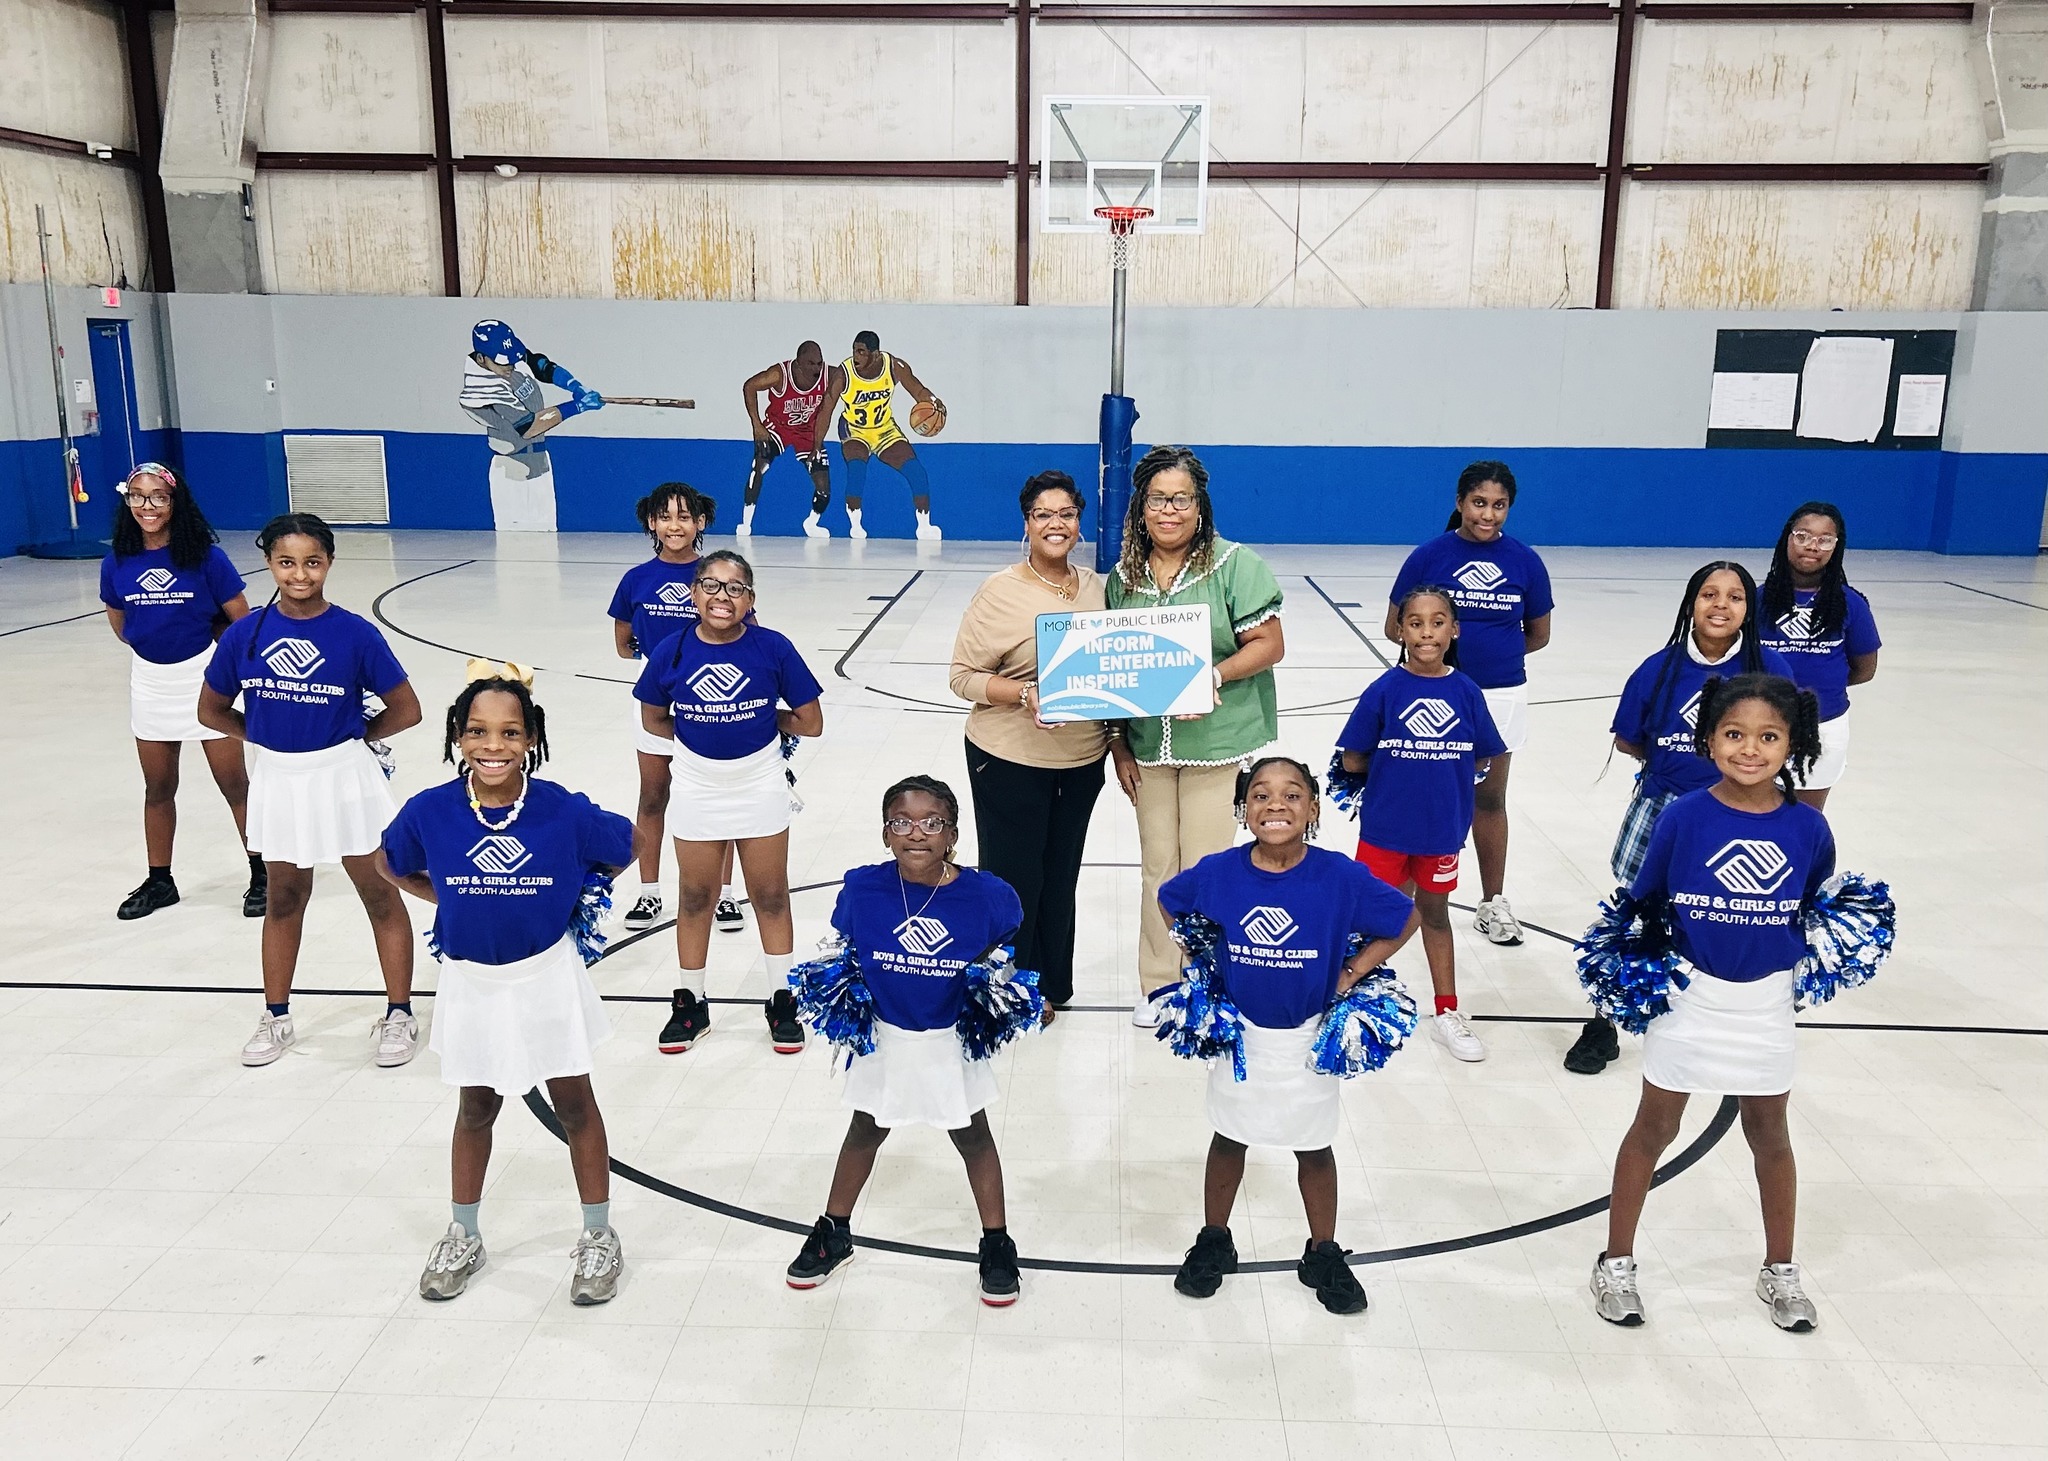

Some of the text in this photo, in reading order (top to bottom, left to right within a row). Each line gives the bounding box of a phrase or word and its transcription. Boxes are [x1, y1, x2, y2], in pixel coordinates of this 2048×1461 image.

[852, 388, 891, 404] LAKERS
[1456, 590, 1464, 598] &
[1466, 591, 1495, 601] GIRLS
[1479, 602, 1512, 611] ALABAMA
[1044, 611, 1202, 632] MOBILE PUBLIC LIBRARY
[1084, 635, 1155, 654] INFORM
[1099, 651, 1195, 672] ENTERTAIN
[241, 678, 345, 696] BOYS & GIRLS CLUBS
[1067, 672, 1139, 690] INSPIRE
[262, 690, 290, 701] SOUTH
[292, 694, 329, 705] ALABAMA
[695, 702, 703, 712] &
[704, 703, 736, 713] GIRLS
[739, 698, 768, 710] CLUBS
[694, 714, 718, 722] SOUTH
[720, 711, 756, 723] ALABAMA
[1681, 733, 1690, 742] &
[1378, 739, 1473, 751] BOYS & GIRLS CLUBS
[1400, 751, 1428, 760] SOUTH
[1429, 752, 1460, 760] ALABAMA
[445, 876, 553, 886] BOYS & GIRLS CLUBS
[458, 887, 468, 895] OF
[469, 887, 497, 895] SOUTH
[1674, 892, 1710, 907] BOYS
[1712, 896, 1727, 909] &
[1729, 898, 1776, 912] GIRLS
[1690, 910, 1789, 925] OF SOUTH ALABA
[873, 951, 895, 961] BOYS
[896, 955, 906, 963] &
[907, 956, 938, 966] GIRLS
[1242, 945, 1251, 955] &
[1252, 948, 1283, 958] GIRLS
[1285, 950, 1318, 959] CLUBS
[893, 964, 920, 975] SOUTH
[1239, 956, 1264, 967] SOUTH
[1265, 960, 1303, 969] ALABAMA
